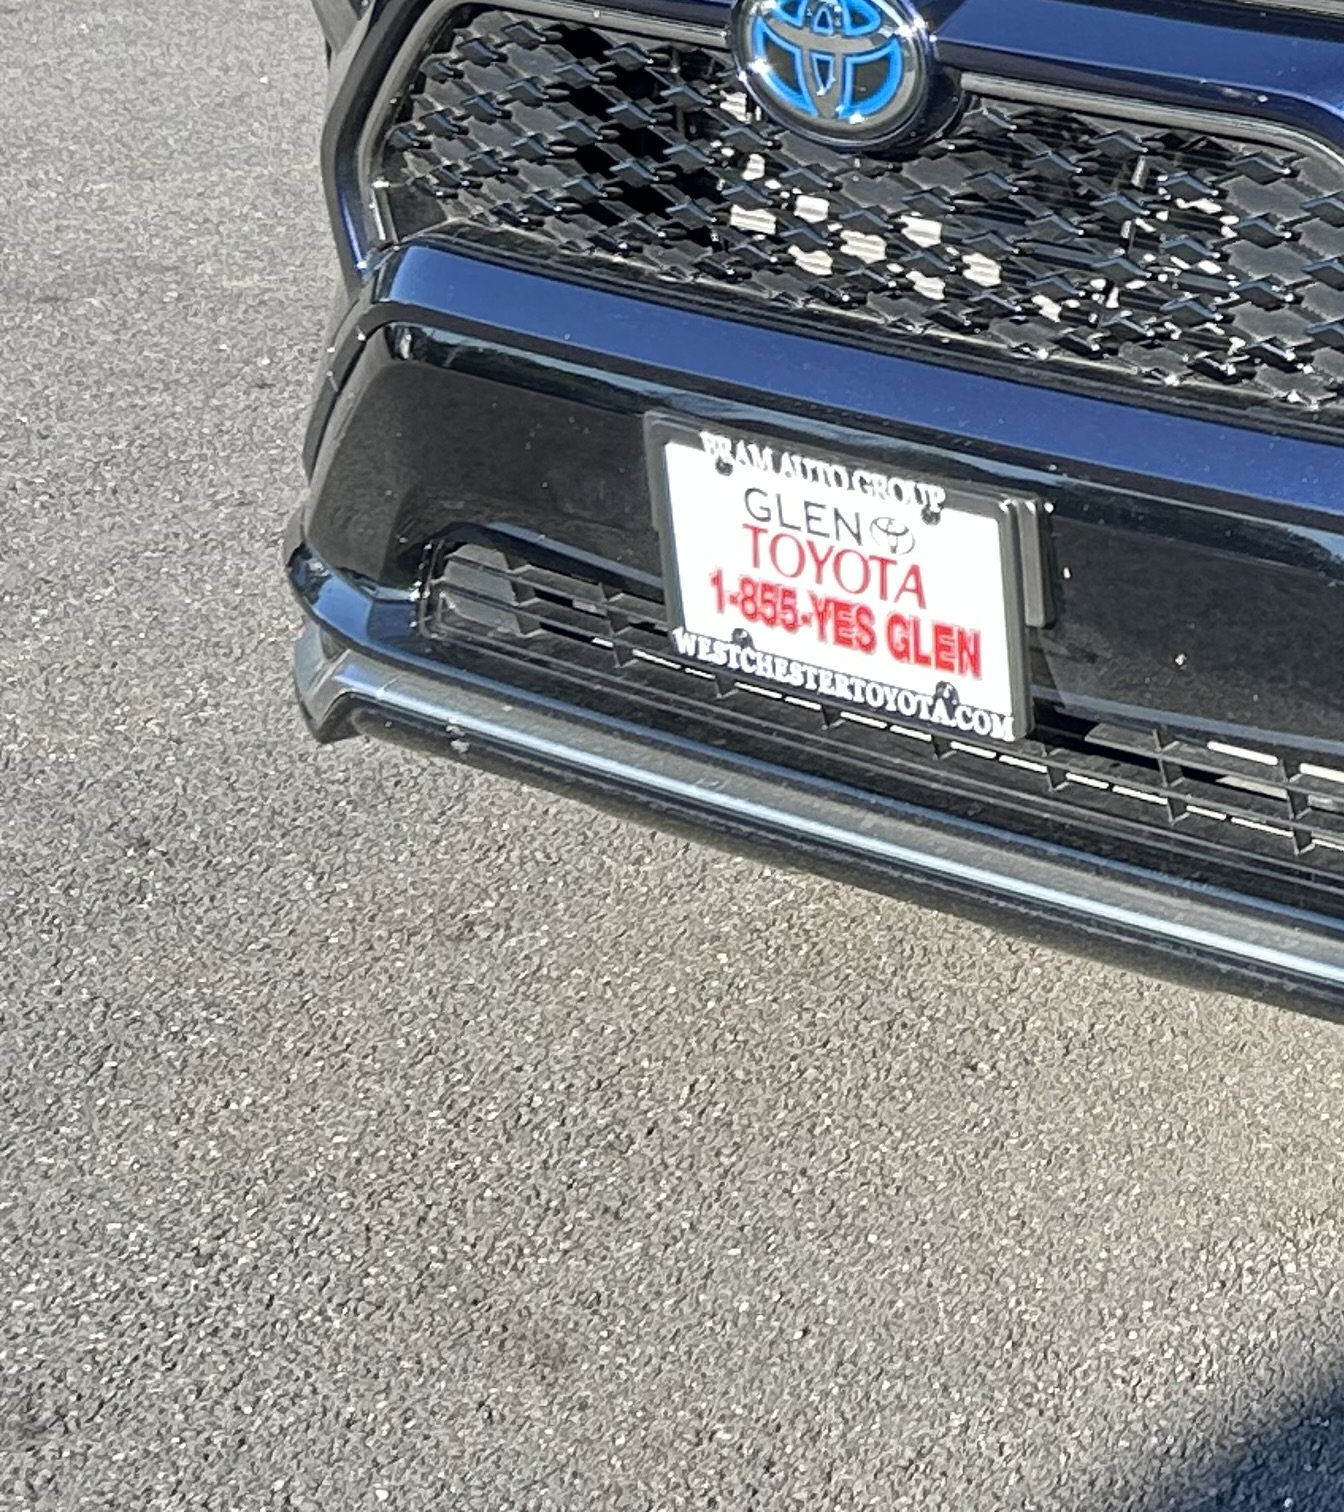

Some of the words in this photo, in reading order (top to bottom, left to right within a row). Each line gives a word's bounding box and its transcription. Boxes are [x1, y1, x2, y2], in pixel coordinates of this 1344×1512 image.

[743, 487, 863, 547] GLEN
[780, 452, 851, 492] AUTO
[852, 468, 947, 514] GROUP
[742, 523, 927, 610] TOYOTA
[710, 567, 878, 655] 1-855-YES
[887, 614, 982, 680] GLEN
[673, 627, 1015, 742] WESTCHESTERTOYOTA.COM
